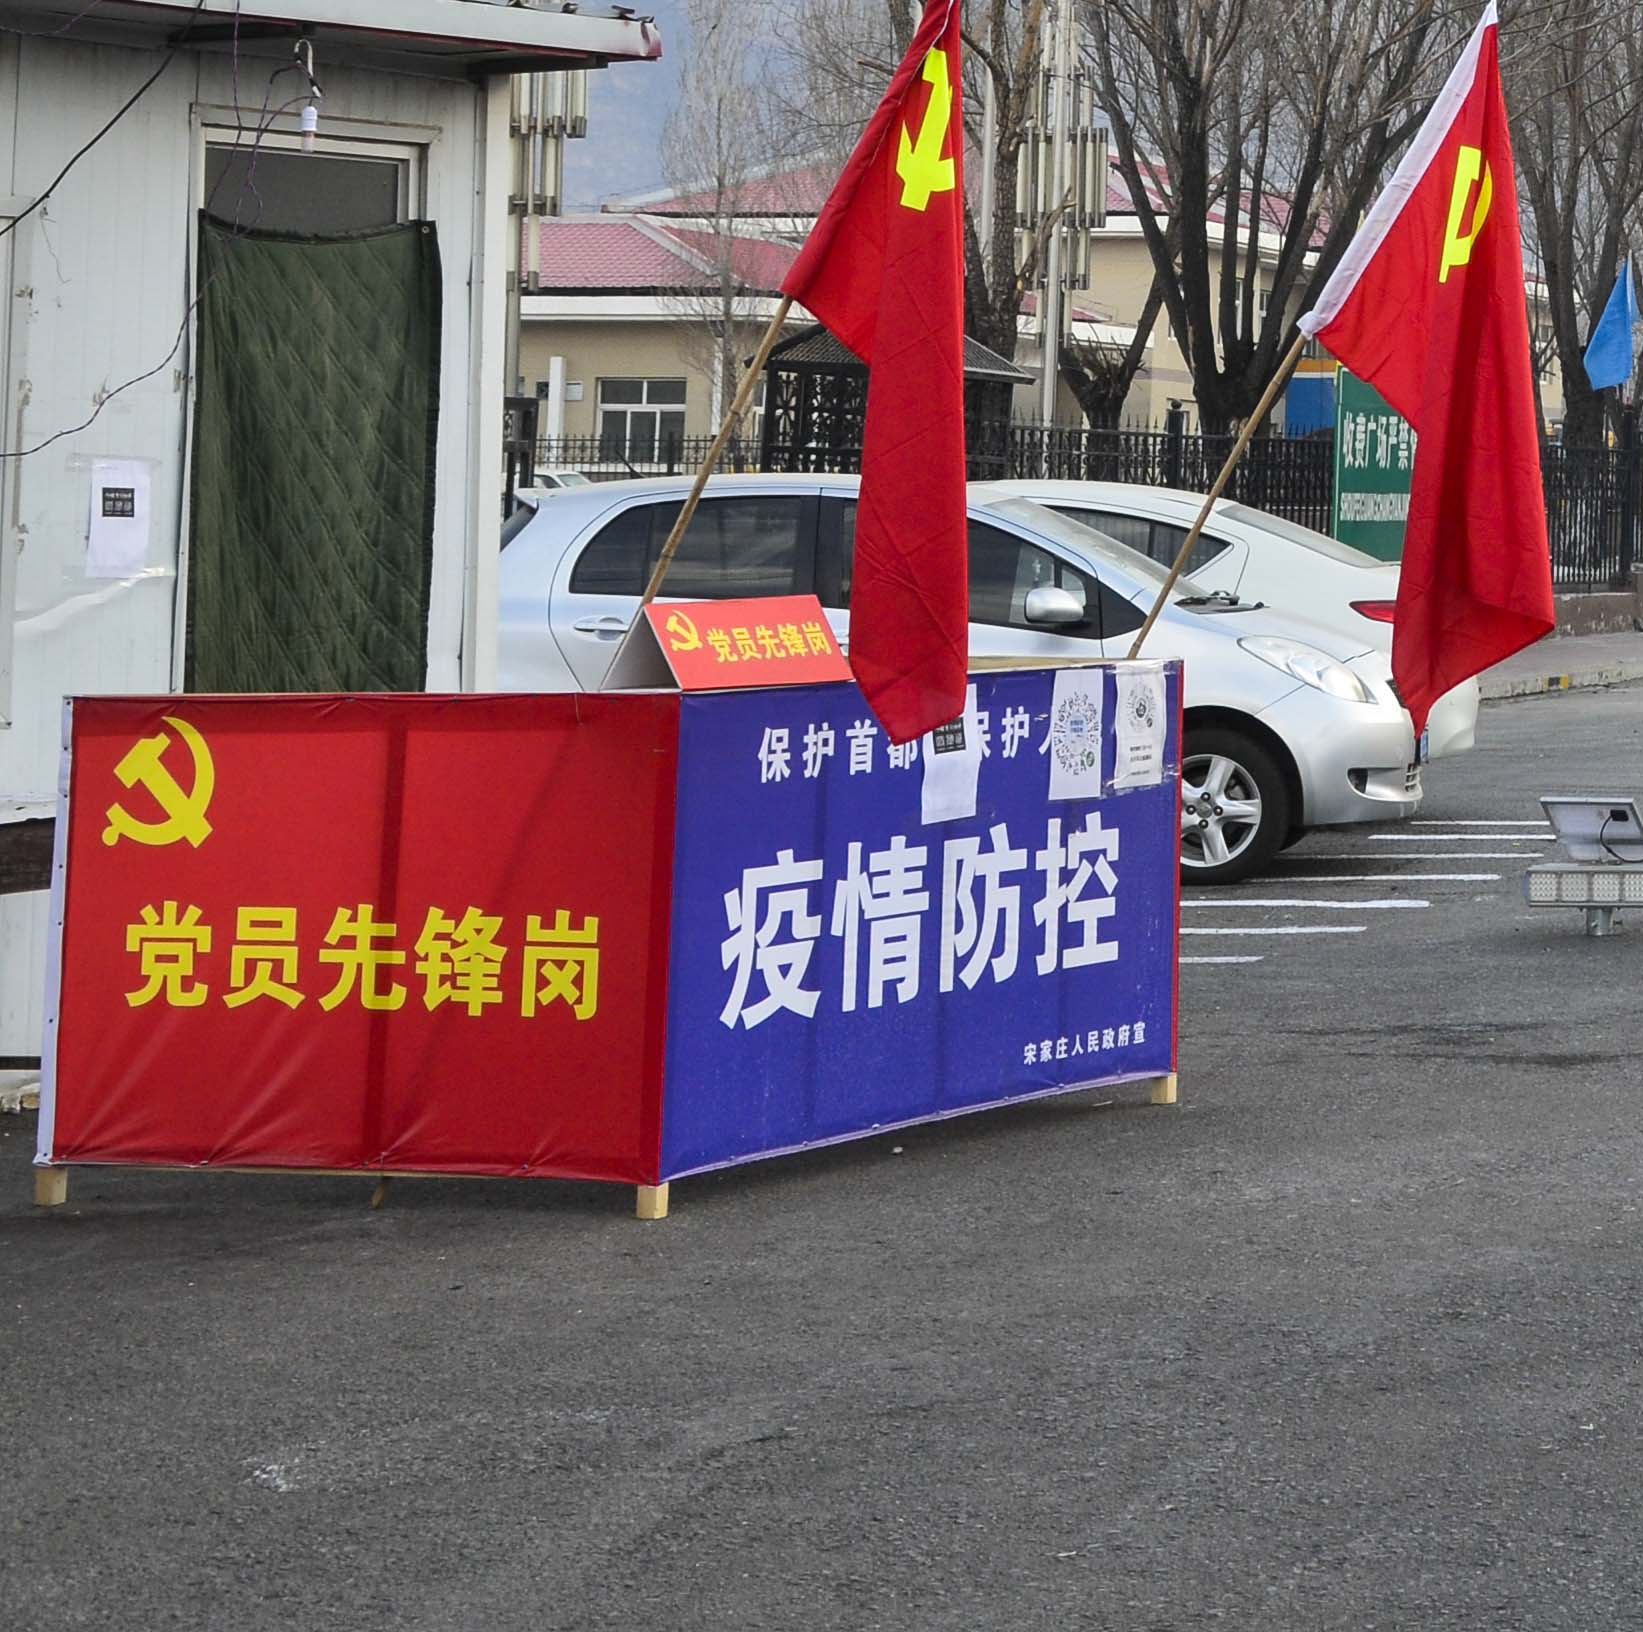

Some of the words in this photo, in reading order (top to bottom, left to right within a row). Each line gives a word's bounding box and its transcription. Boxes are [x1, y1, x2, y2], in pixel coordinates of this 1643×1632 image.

[706, 621, 832, 663] 党员先锋岗
[125, 900, 601, 1021] 党员先锋岗
[719, 811, 1120, 1032] 疫情防控
[1023, 1021, 1146, 1066] 宋家庄人民政府宣
